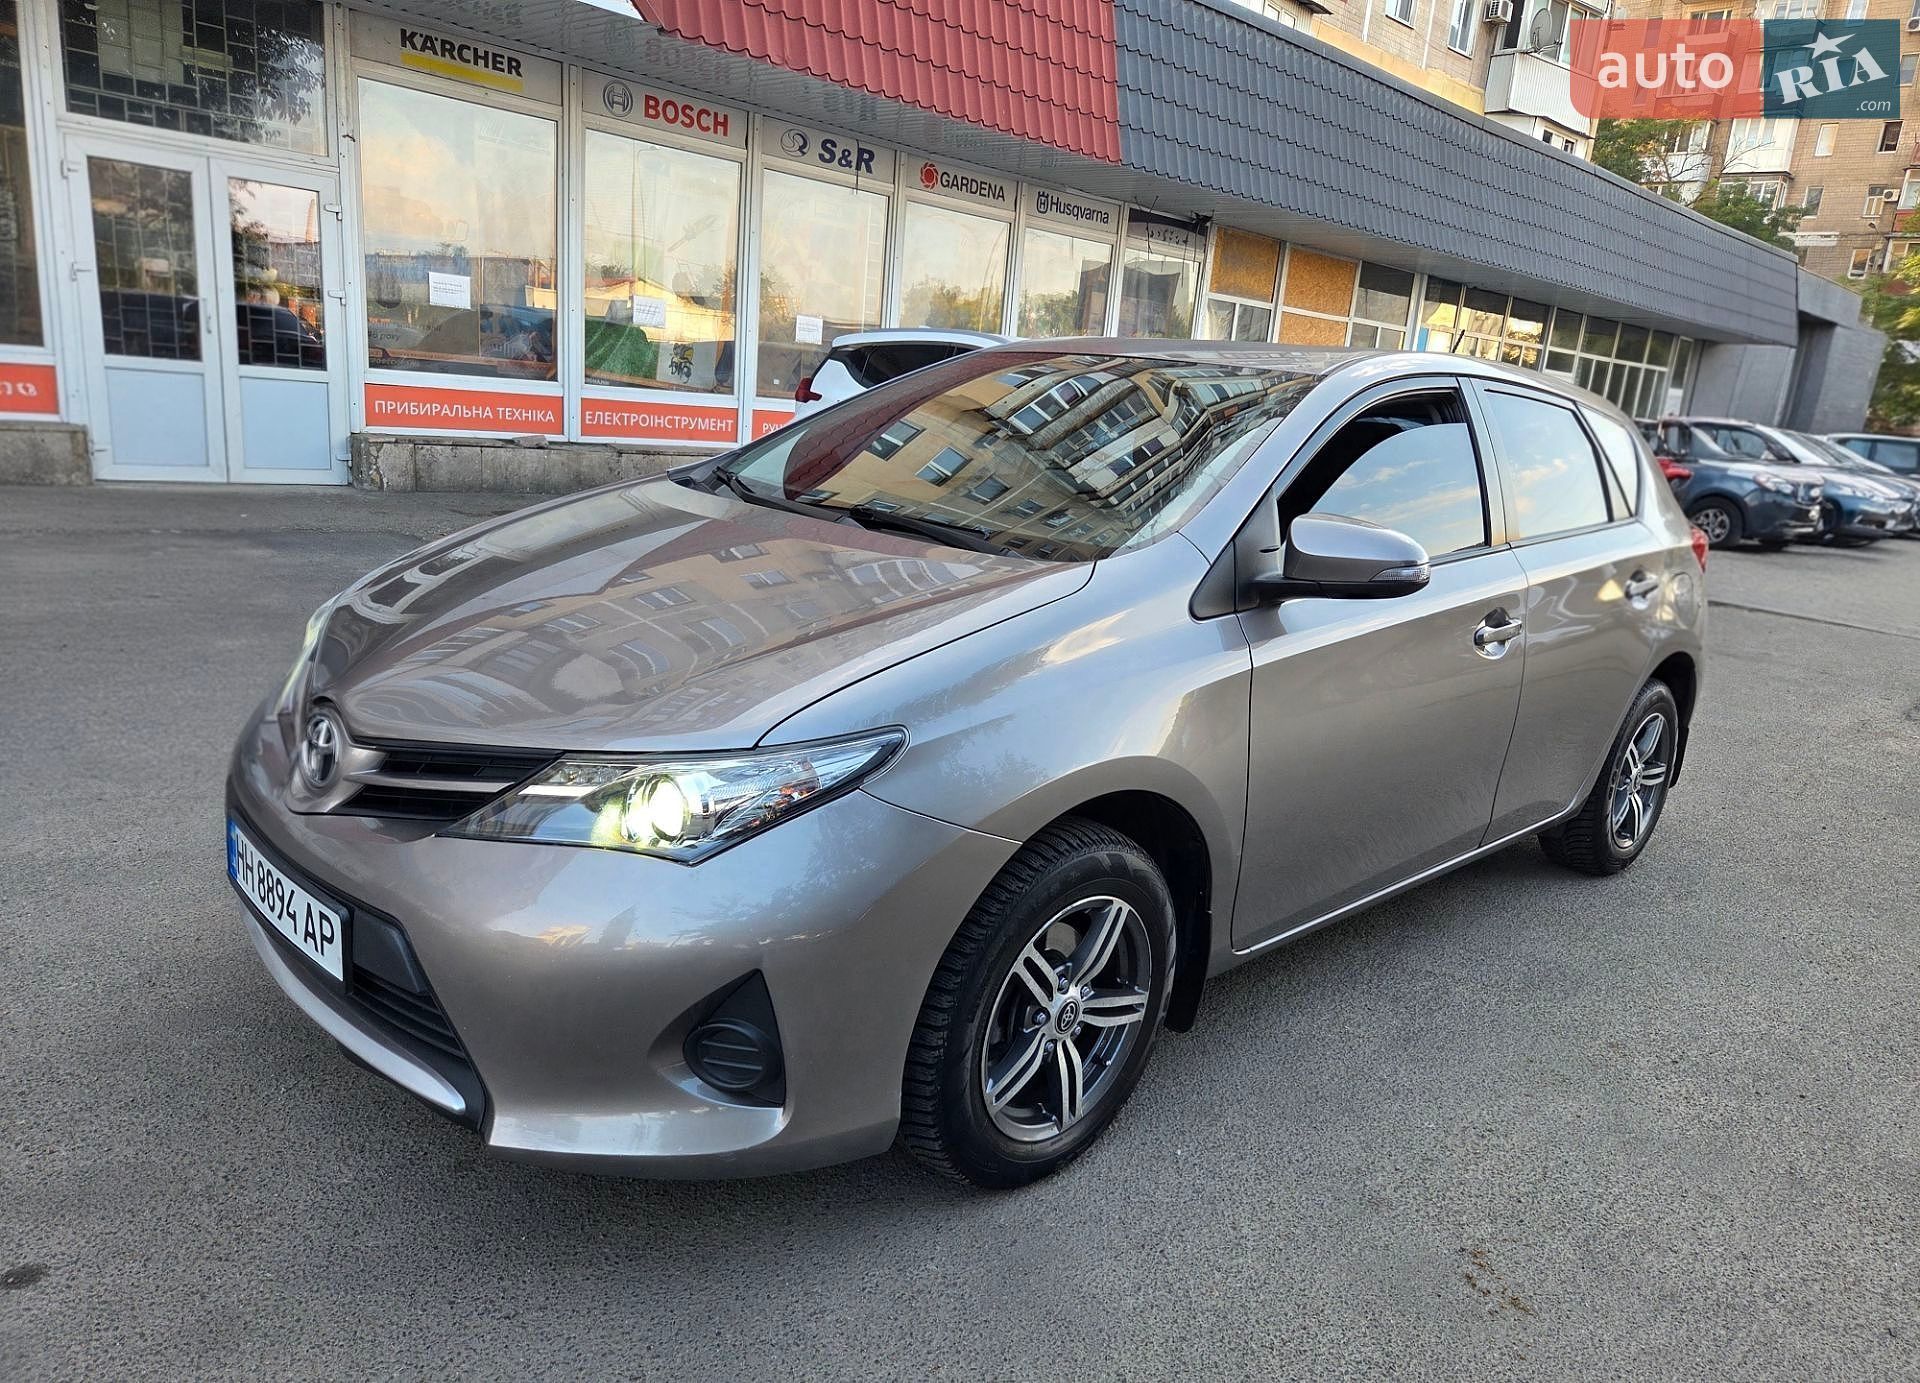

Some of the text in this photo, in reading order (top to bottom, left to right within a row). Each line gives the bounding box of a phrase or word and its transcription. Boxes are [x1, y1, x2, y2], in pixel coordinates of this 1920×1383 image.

[400, 28, 523, 78] KÄRCHER
[643, 94, 729, 137] BOSCH
[818, 138, 875, 174] S&R
[940, 171, 1005, 201] GARDENA
[1050, 195, 1109, 224] Husqvarna
[374, 400, 555, 422] ПРИБИРАЛЬНА ТЕХНІКА
[585, 411, 733, 432] ЕЛЕКТРОІНСТРУМЕНТ
[257, 859, 298, 935] 8894
[303, 902, 335, 956] AP
